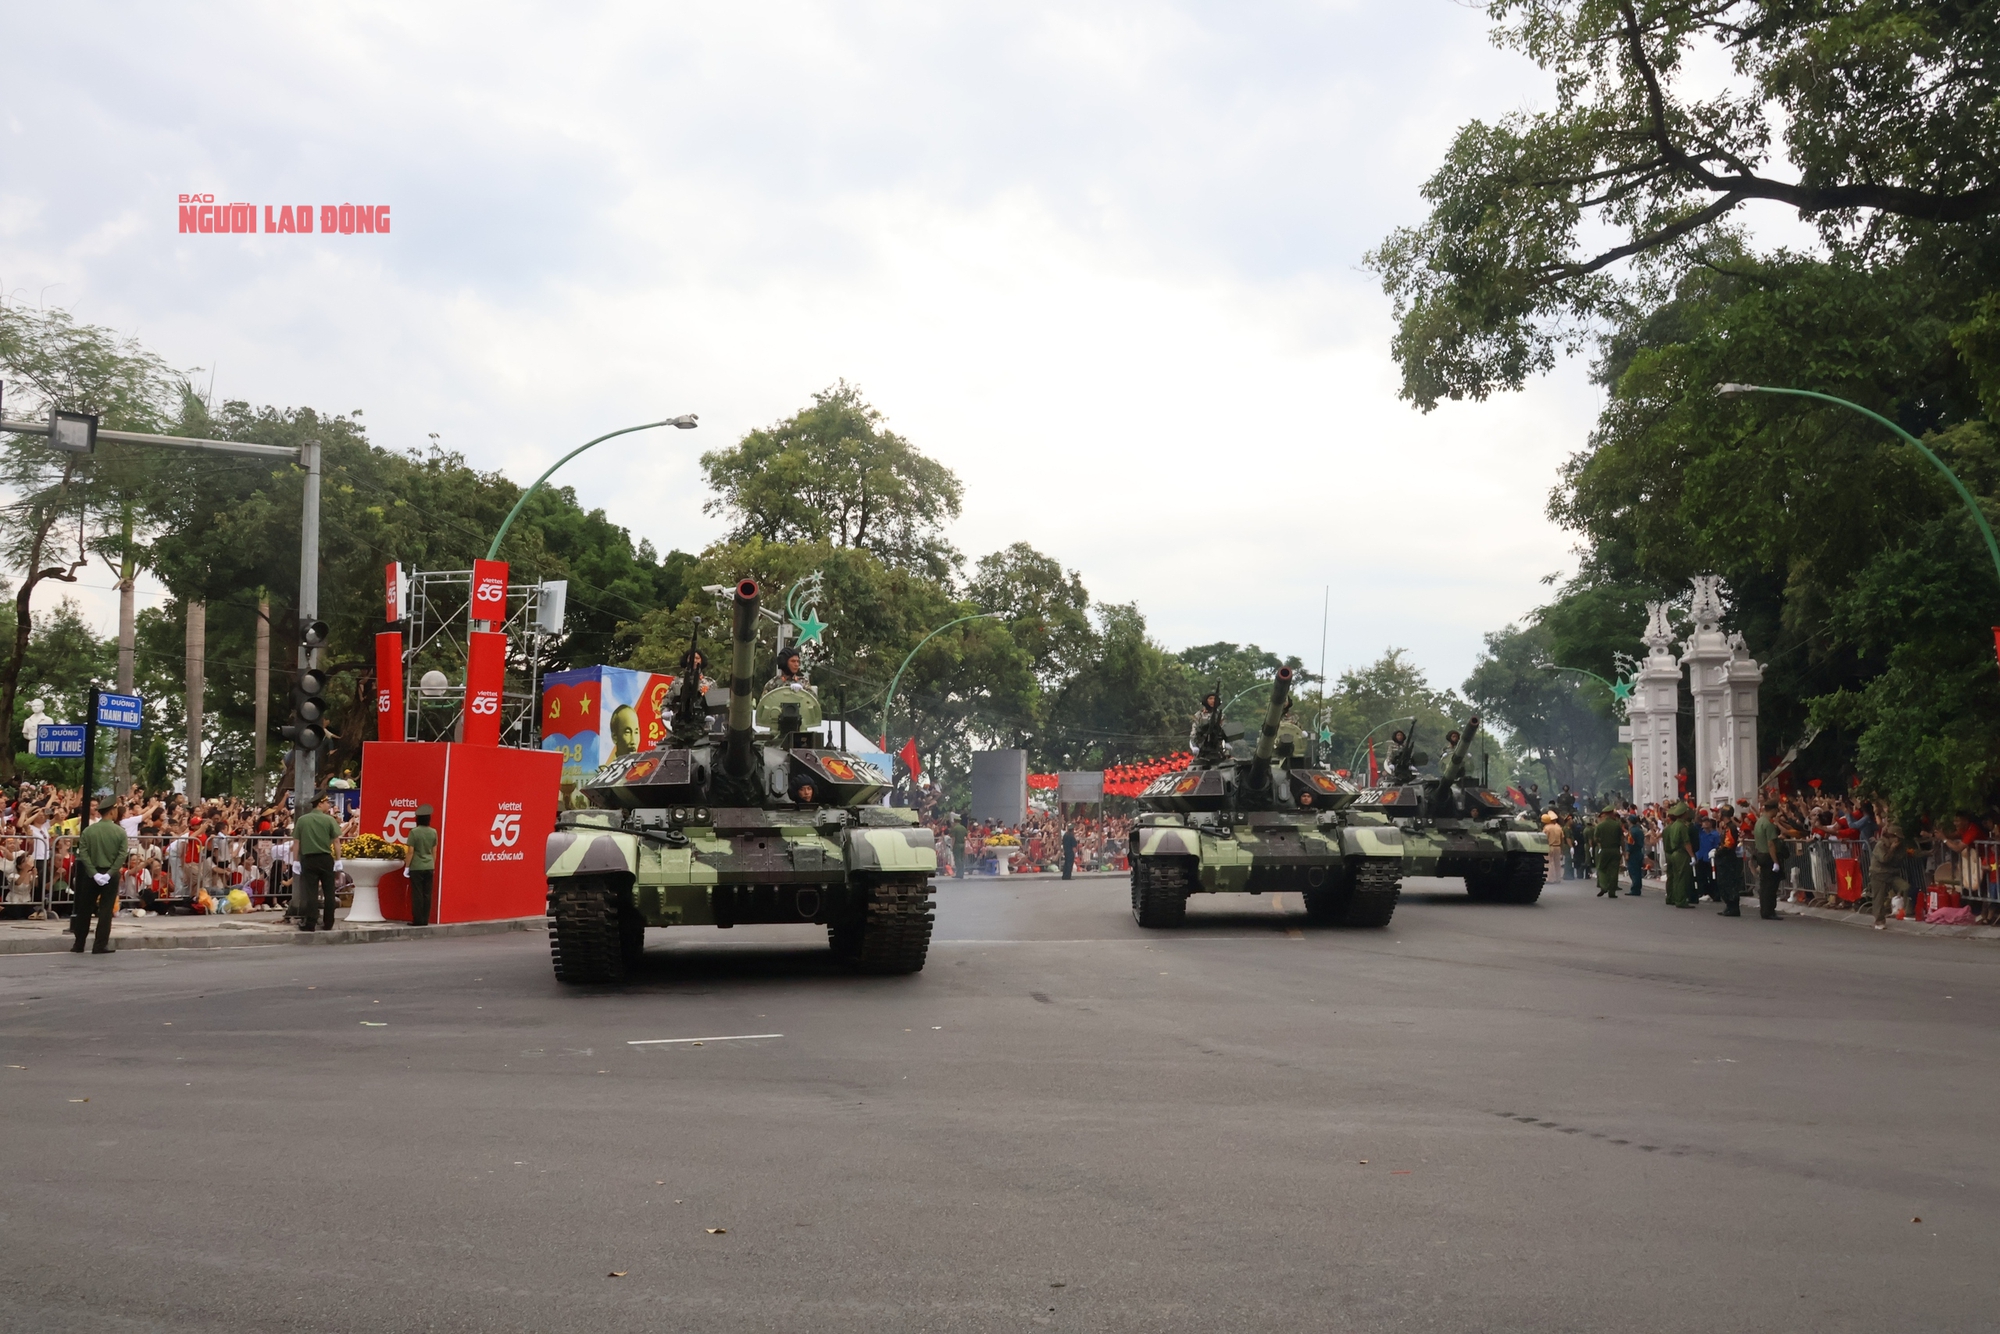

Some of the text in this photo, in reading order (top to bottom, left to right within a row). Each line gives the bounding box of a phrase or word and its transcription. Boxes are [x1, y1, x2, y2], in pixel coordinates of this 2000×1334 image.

[482, 577, 503, 585] viettel
[476, 583, 503, 602] 5G
[471, 696, 498, 715] 5G
[100, 708, 139, 724] THANH NIÊN
[648, 721, 667, 739] 2-
[61, 738, 82, 752] KHUÊ
[389, 798, 418, 808] viettel
[498, 802, 522, 811] viettel
[382, 810, 418, 844] 5G
[490, 813, 522, 848] 5G
[481, 849, 524, 862] CUỘC SỐNG MỚI
